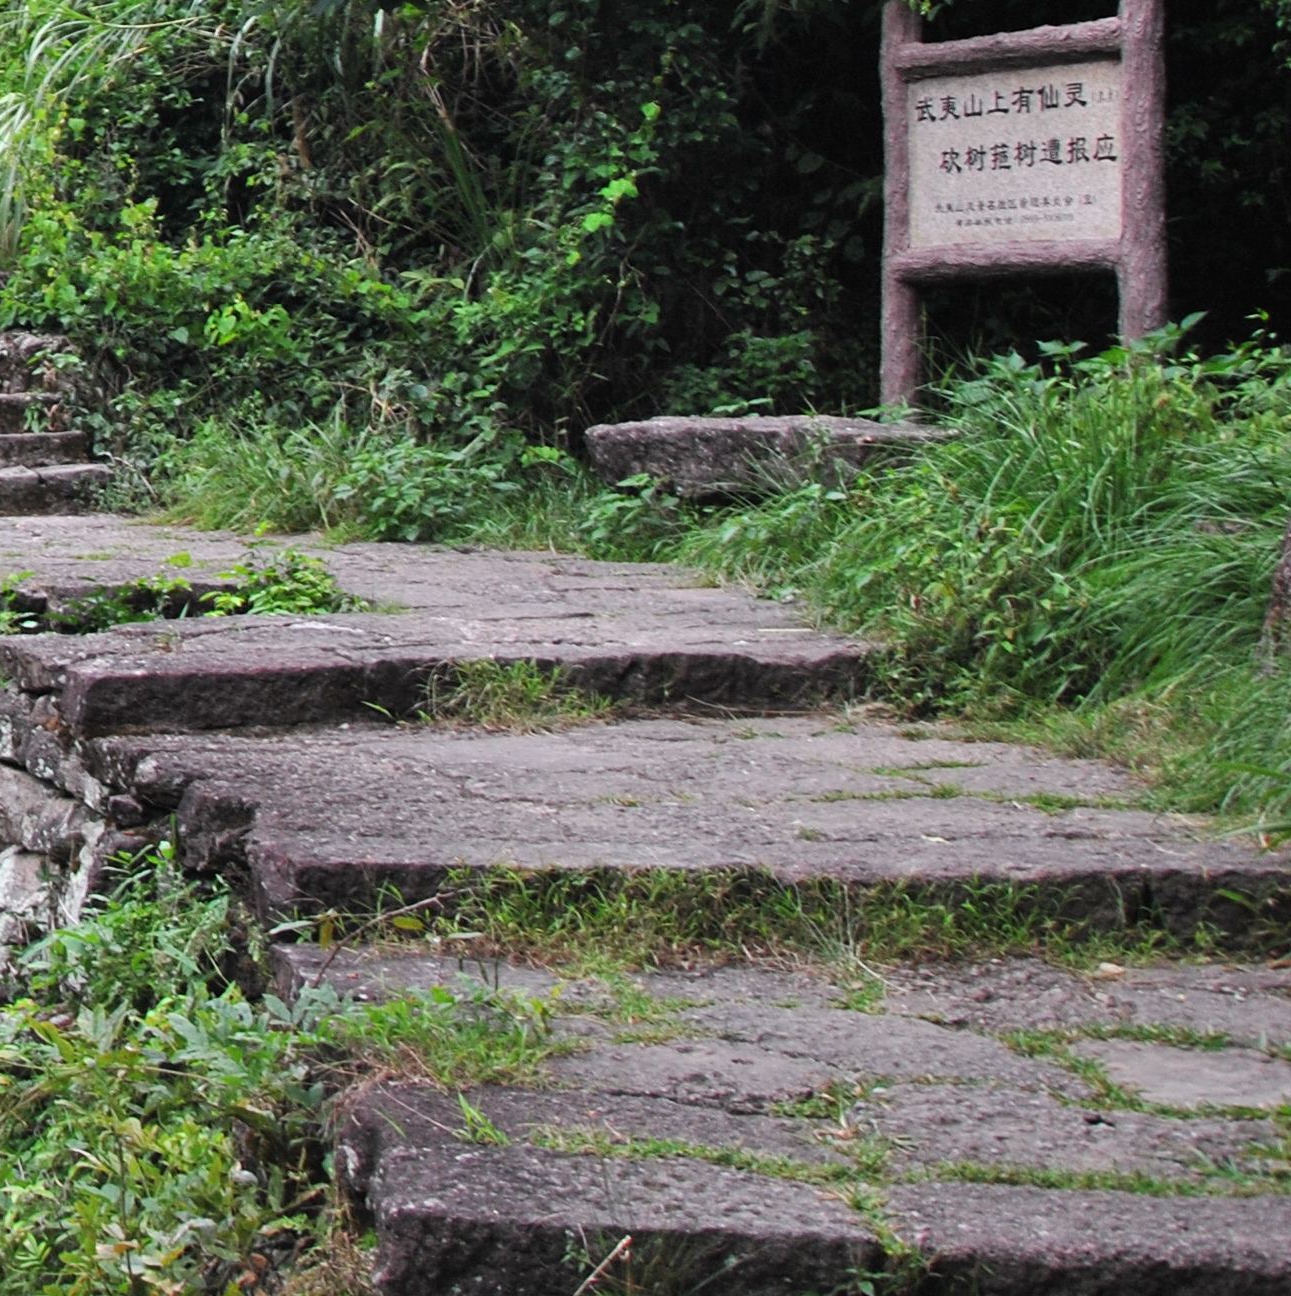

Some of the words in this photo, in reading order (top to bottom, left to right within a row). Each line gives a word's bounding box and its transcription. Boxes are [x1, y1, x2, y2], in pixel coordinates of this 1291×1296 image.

[915, 82, 1087, 122] 武夷山上有仙灵
